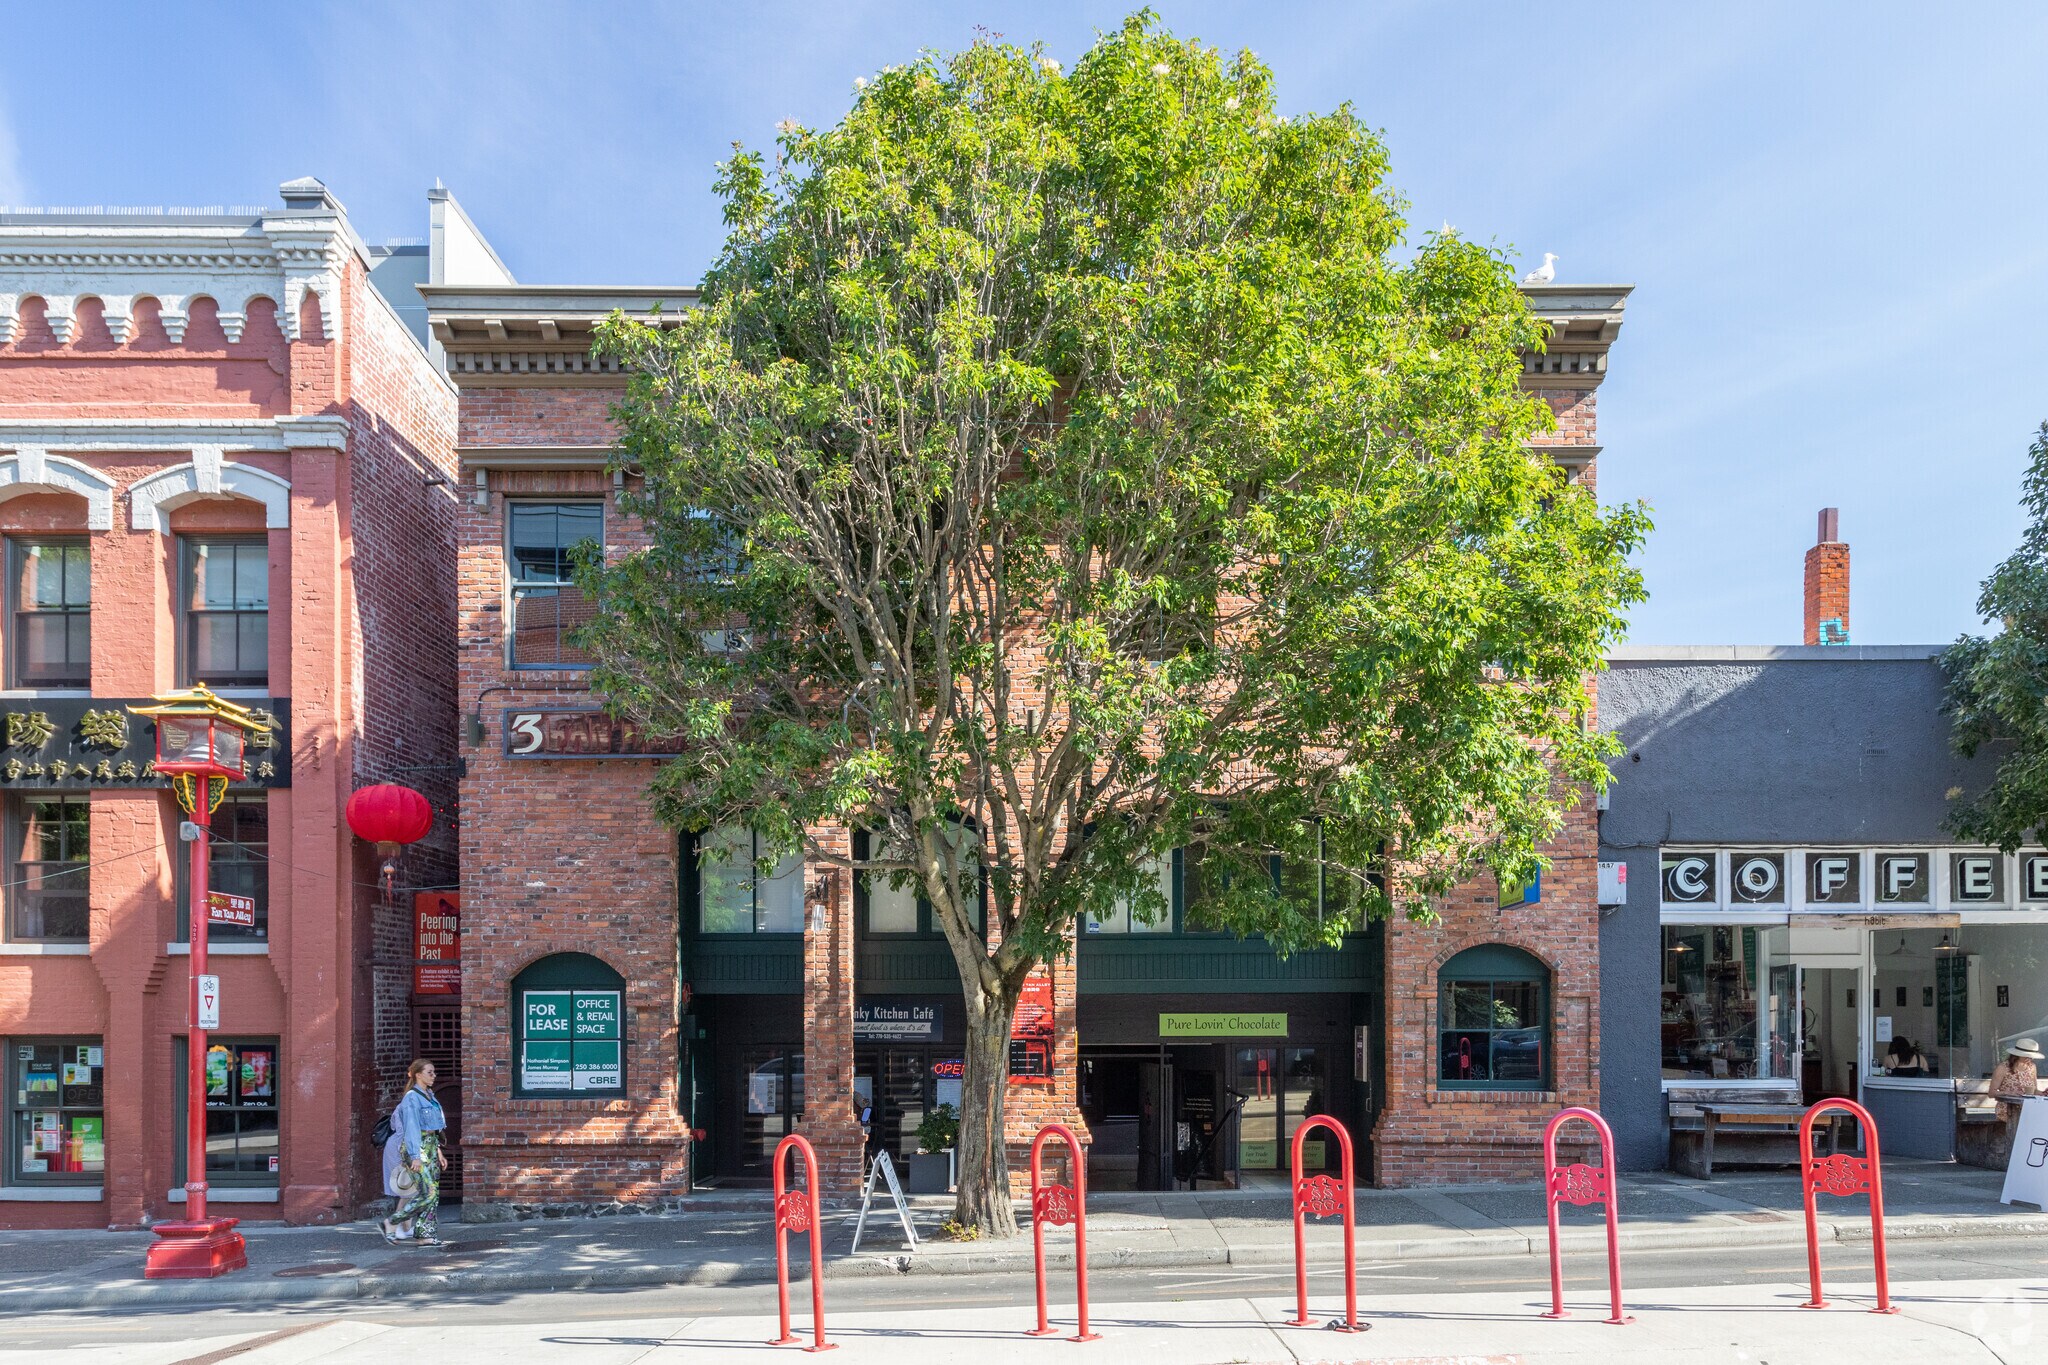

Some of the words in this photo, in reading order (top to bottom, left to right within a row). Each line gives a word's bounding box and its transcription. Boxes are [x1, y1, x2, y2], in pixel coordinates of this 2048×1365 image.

[512, 713, 543, 753] 3
[1668, 857, 2048, 901] COFFEE
[211, 906, 223, 918] Fan
[223, 908, 235, 919] Tan
[235, 910, 252, 923] Alley
[1864, 916, 1886, 926] habit
[420, 912, 457, 932] Peering
[420, 930, 437, 945] into
[439, 930, 454, 945] the
[420, 945, 442, 960] Past
[529, 1004, 556, 1016] FOR
[577, 999, 610, 1009] OFFICE
[577, 1012, 584, 1021] &
[587, 1012, 615, 1021] RETAIL
[854, 1006, 870, 1021] nky
[874, 1006, 909, 1020] Kitchen
[913, 1006, 934, 1020] Café
[529, 1019, 568, 1031] LEASE
[577, 1024, 605, 1034] SPACE
[1167, 1018, 1192, 1030] Pure
[1228, 1016, 1281, 1030] Chocolate
[589, 1076, 617, 1084] CBRE
